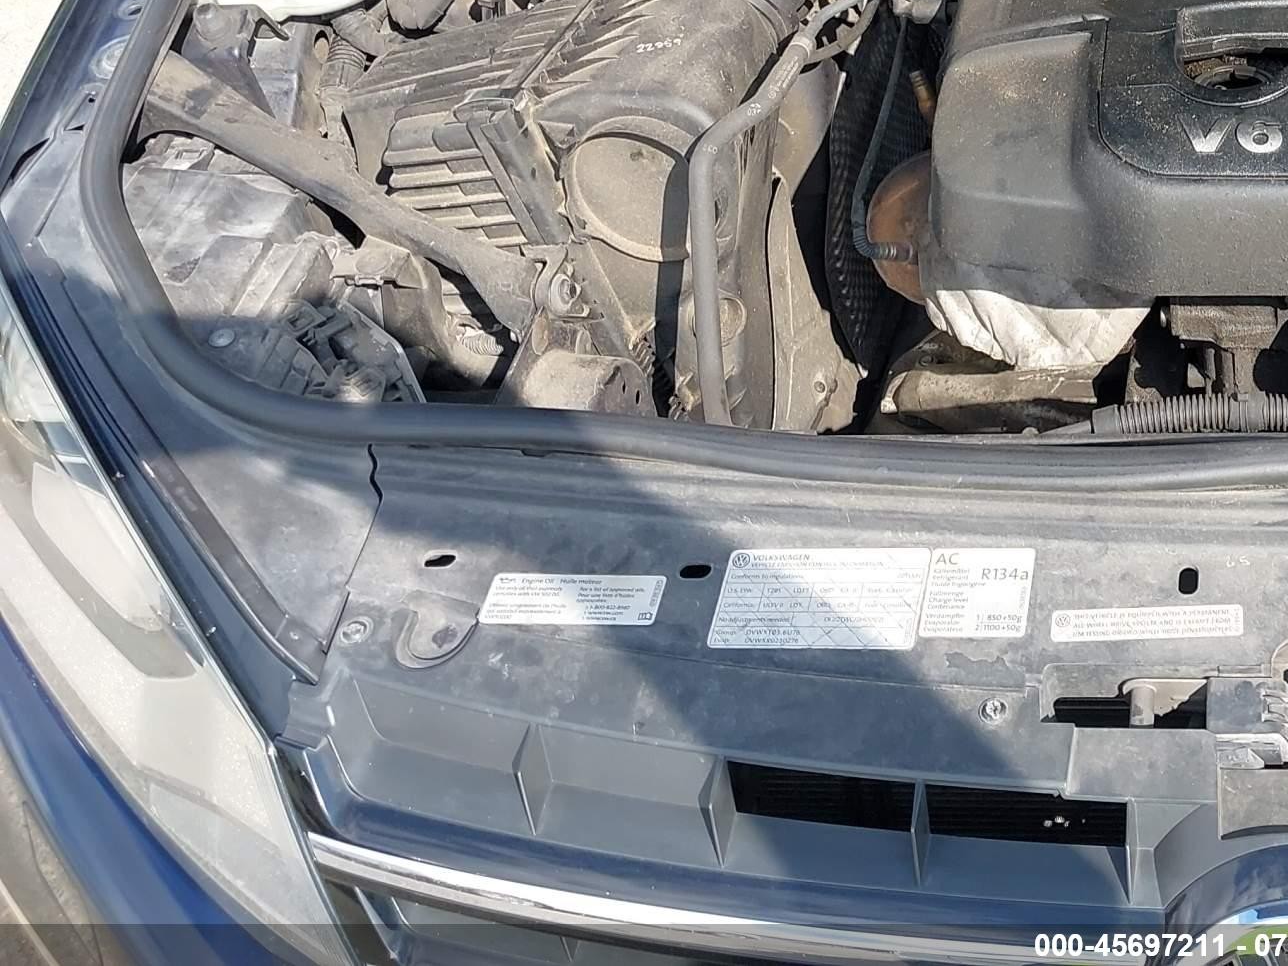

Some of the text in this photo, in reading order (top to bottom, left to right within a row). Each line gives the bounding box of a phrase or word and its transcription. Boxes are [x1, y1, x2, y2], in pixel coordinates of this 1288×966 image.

[1178, 116, 1283, 154] V6
[753, 554, 810, 562] VOLKSWAGEN
[935, 552, 961, 565] AC
[981, 567, 1030, 581] R134a
[521, 577, 544, 586] Engine
[559, 577, 578, 585] Huile
